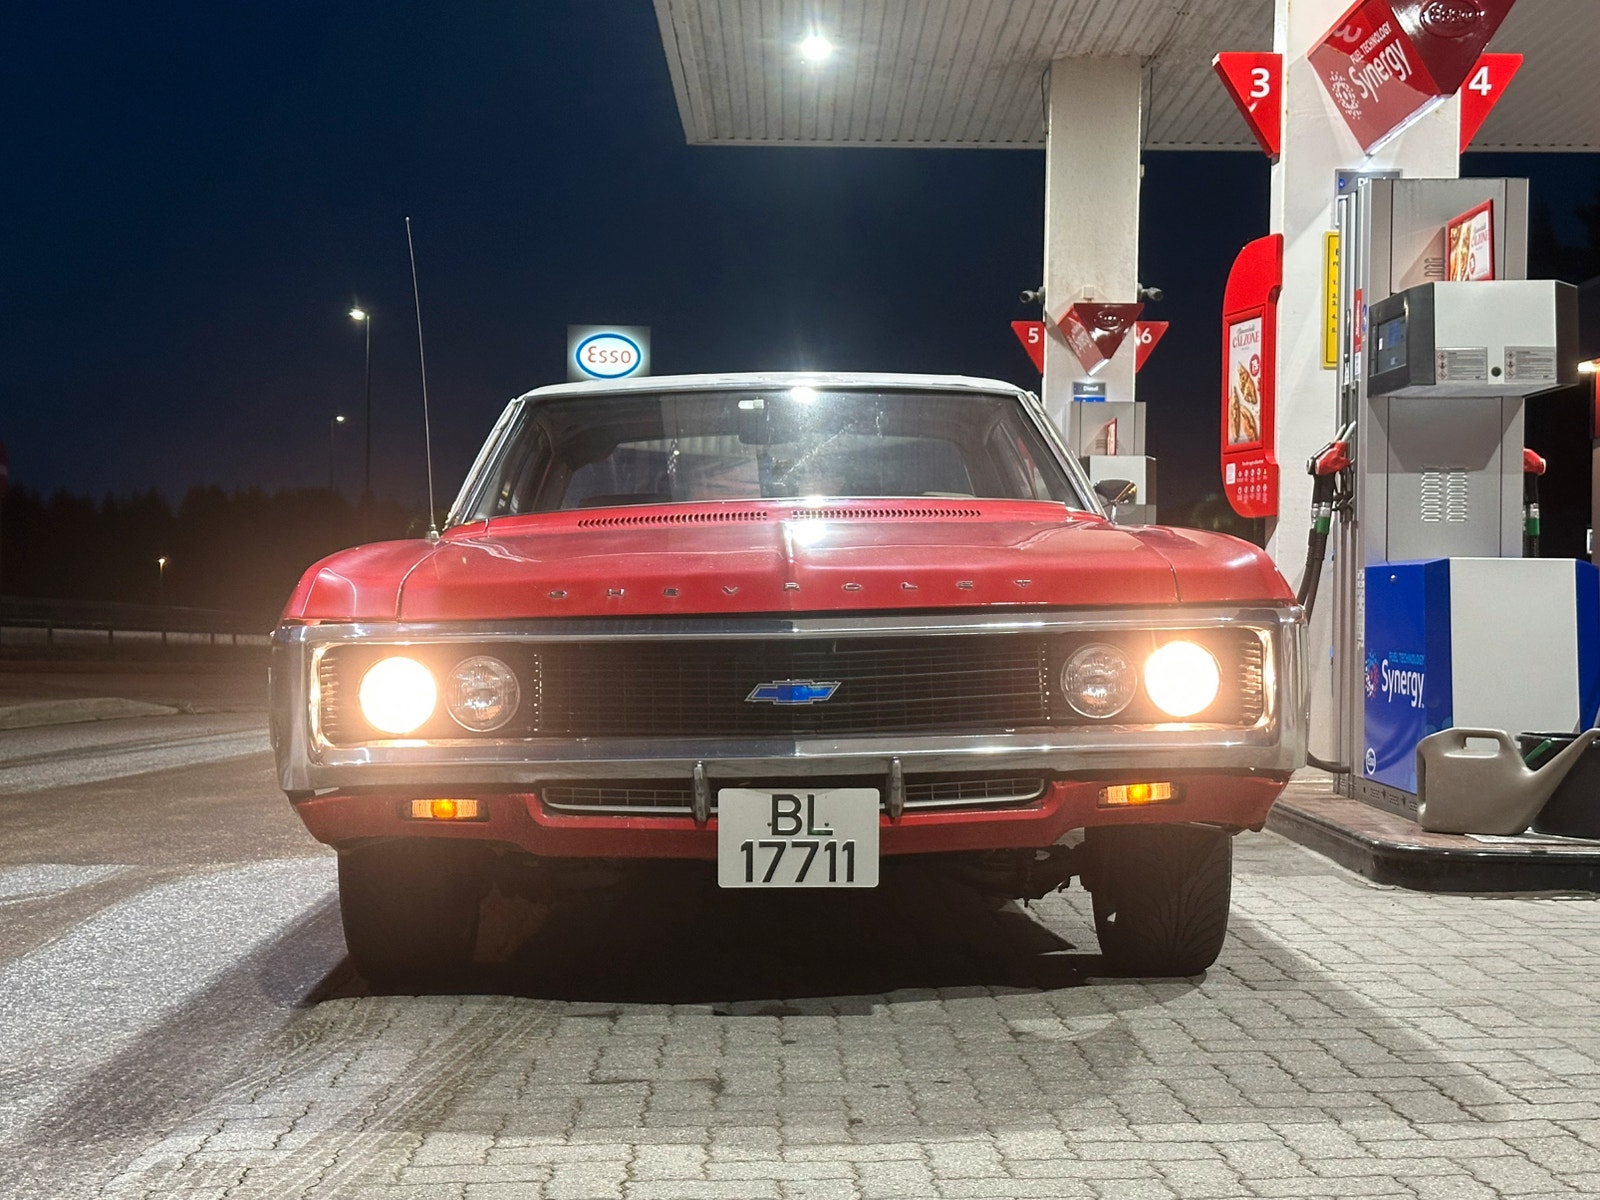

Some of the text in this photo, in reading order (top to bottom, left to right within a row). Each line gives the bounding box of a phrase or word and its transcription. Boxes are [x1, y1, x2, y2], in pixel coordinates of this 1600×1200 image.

[1350, 21, 1392, 65] FUEL TECHNOLOGY
[1249, 67, 1270, 98] 3
[1348, 38, 1412, 103] Synergy
[1468, 66, 1492, 96] 4
[1028, 327, 1039, 344] 5
[1141, 327, 1152, 344] 6
[587, 345, 631, 364] Esso
[547, 578, 1032, 599] CHEVROLET
[1381, 658, 1424, 709] Synergy
[771, 793, 834, 836] BL
[740, 840, 855, 883] 17711
